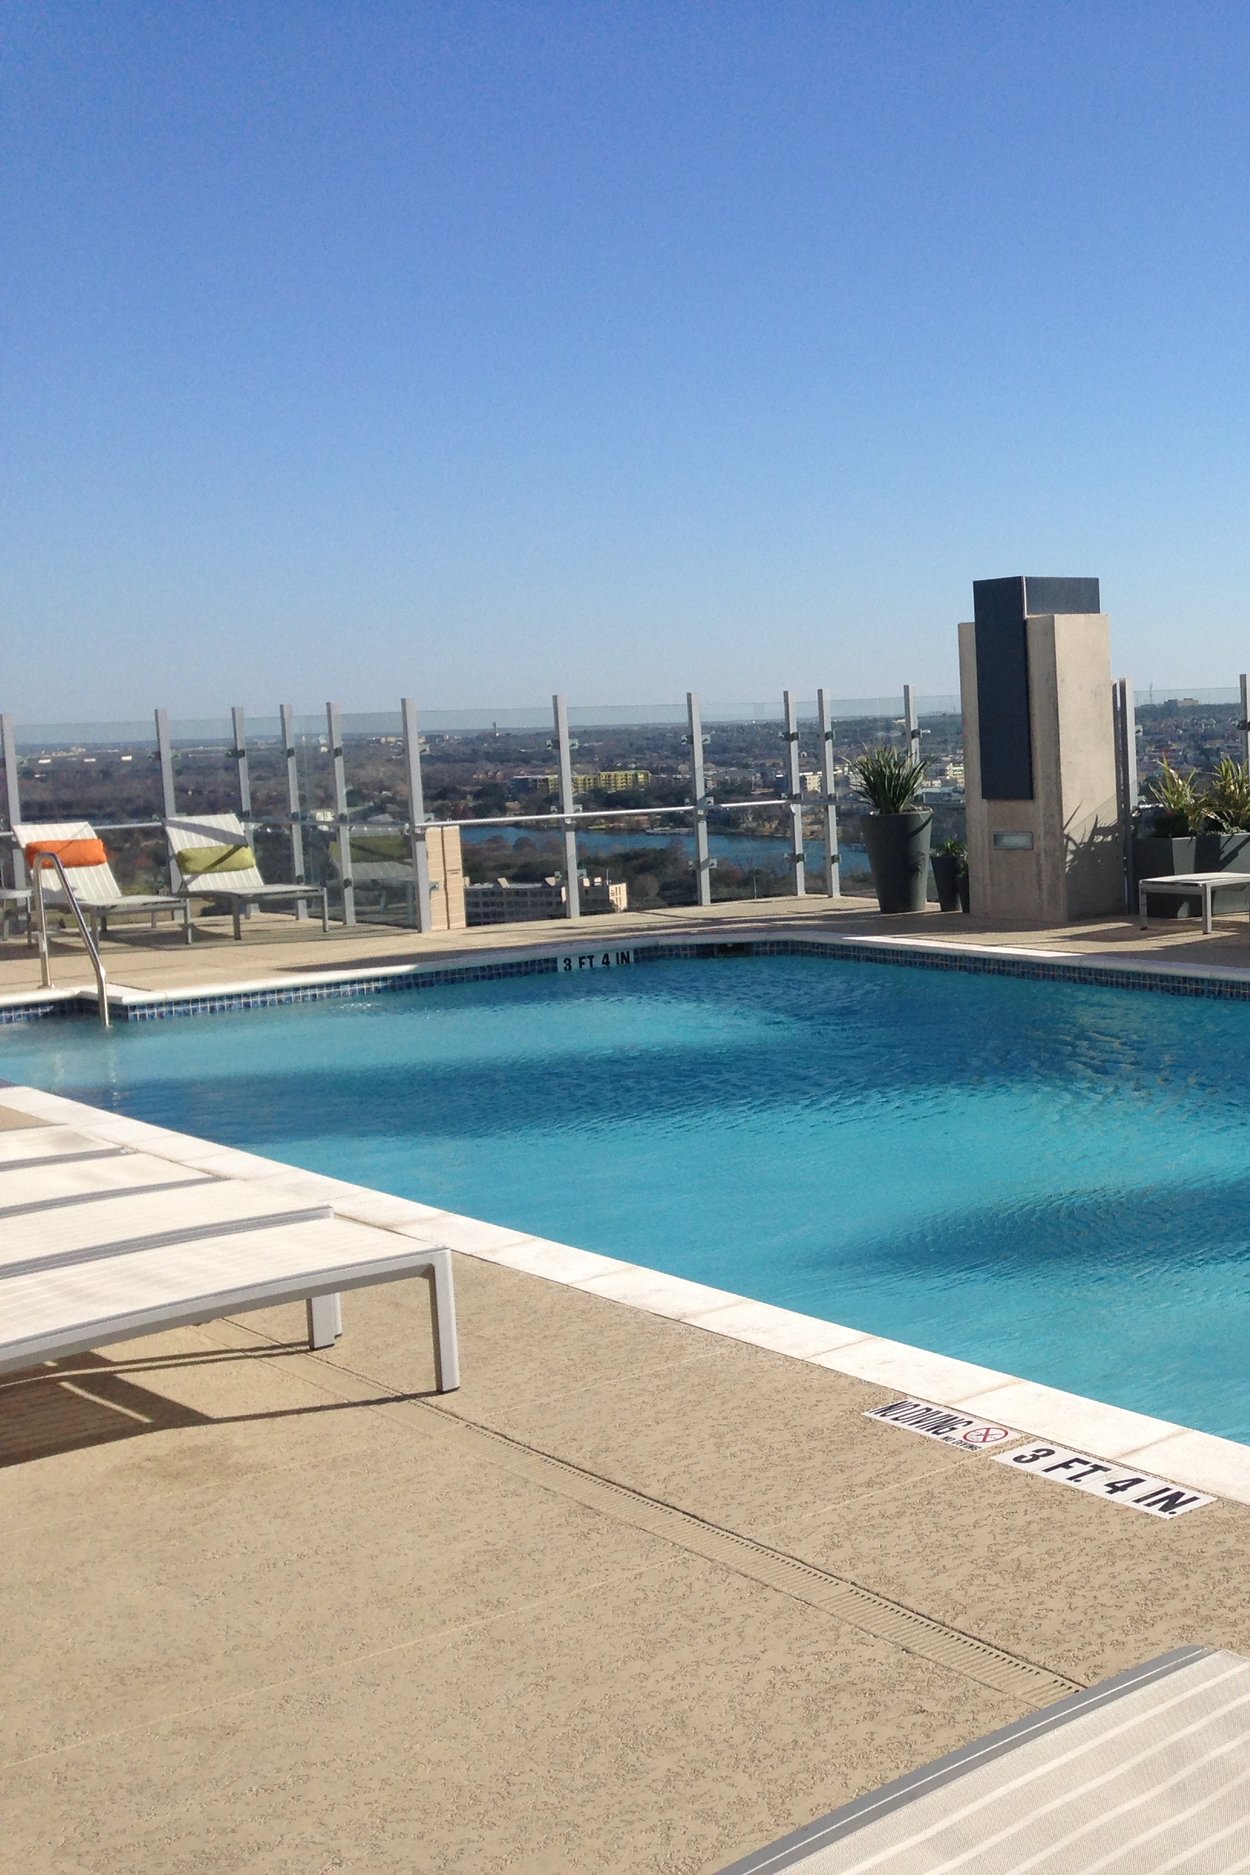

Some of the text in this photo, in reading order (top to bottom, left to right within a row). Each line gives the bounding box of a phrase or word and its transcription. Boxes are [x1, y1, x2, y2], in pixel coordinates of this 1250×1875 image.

[563, 951, 630, 971] 3 FT 4 IN
[868, 1400, 974, 1435] NO DIVING
[1012, 1448, 1201, 1515] 3 FT. 4 IN.
